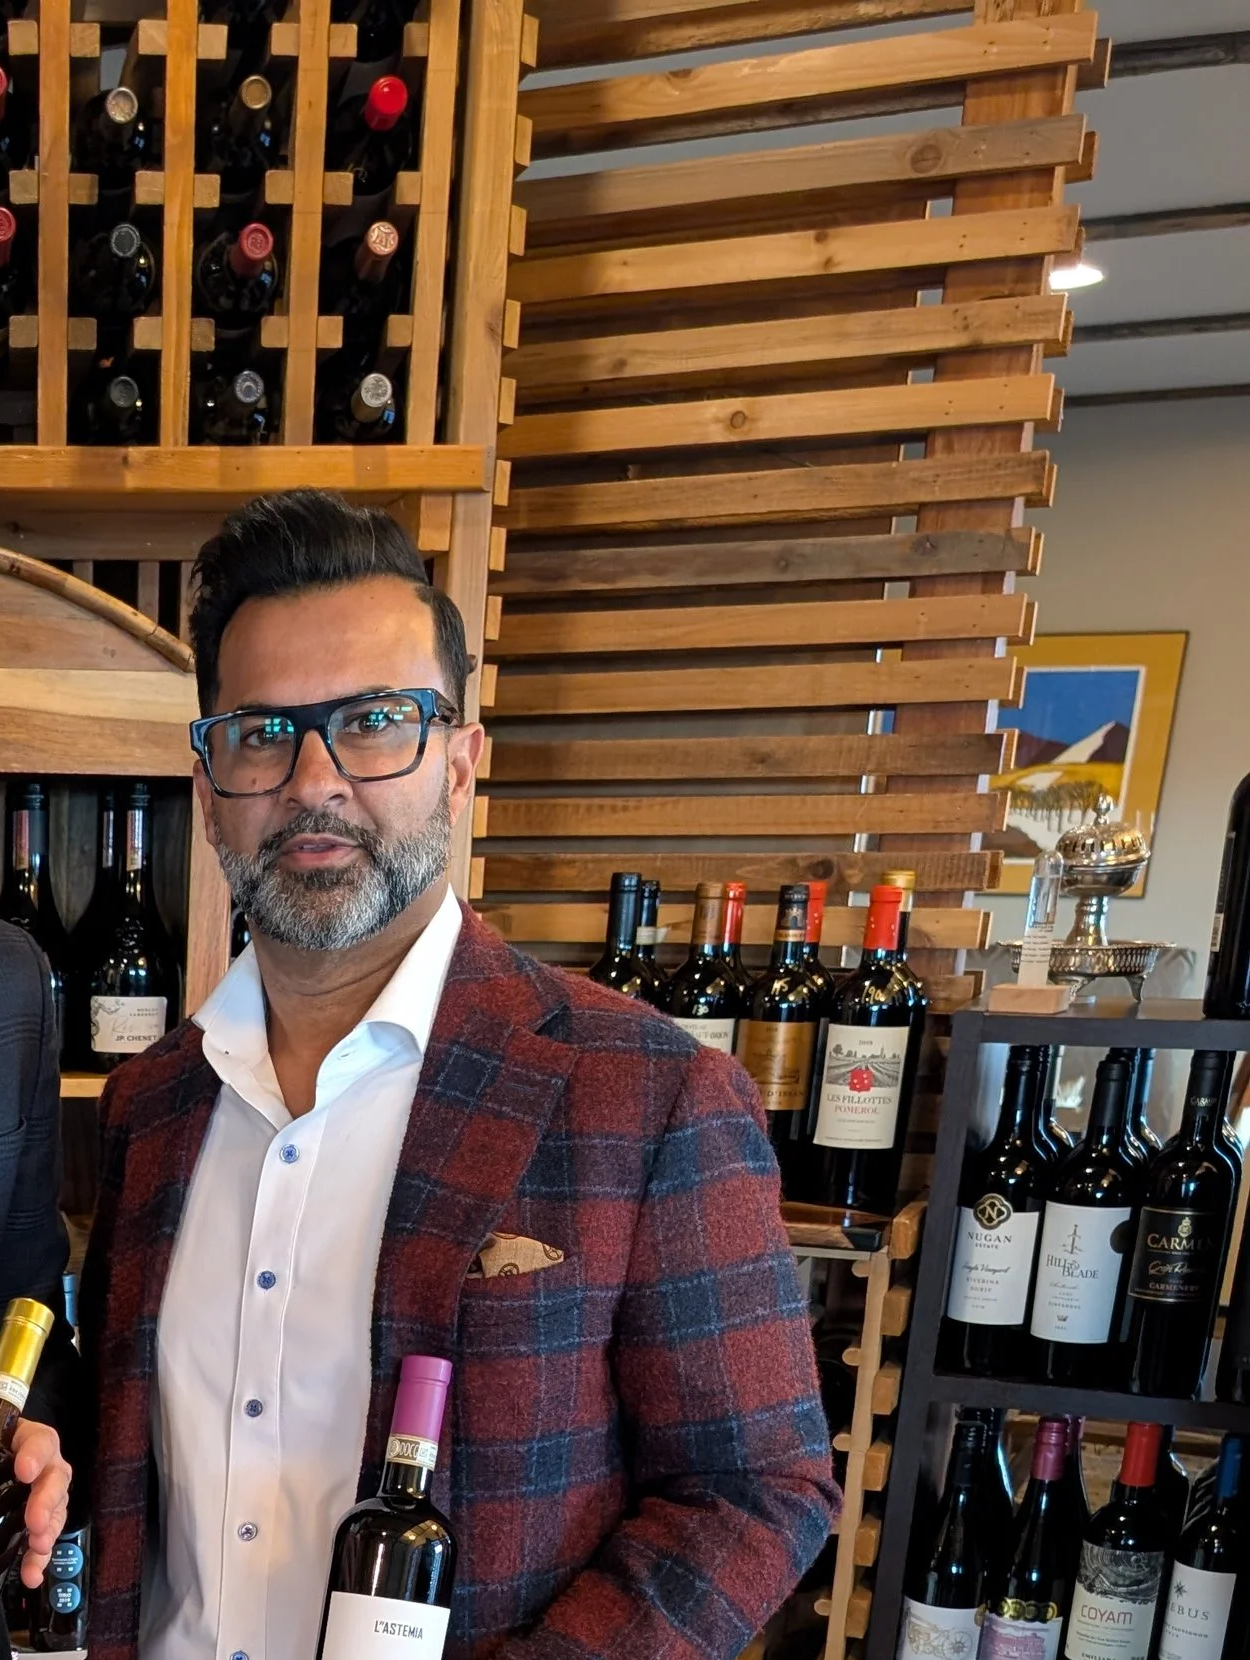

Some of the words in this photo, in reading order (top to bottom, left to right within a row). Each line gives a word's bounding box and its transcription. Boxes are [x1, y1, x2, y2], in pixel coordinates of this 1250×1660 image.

[826, 1093, 841, 1102] LES
[834, 1105, 880, 1115] POMEROL
[966, 1231, 1012, 1244] NUGAN
[1063, 1267, 1098, 1279] BLADE
[1081, 1605, 1133, 1625] COYAM
